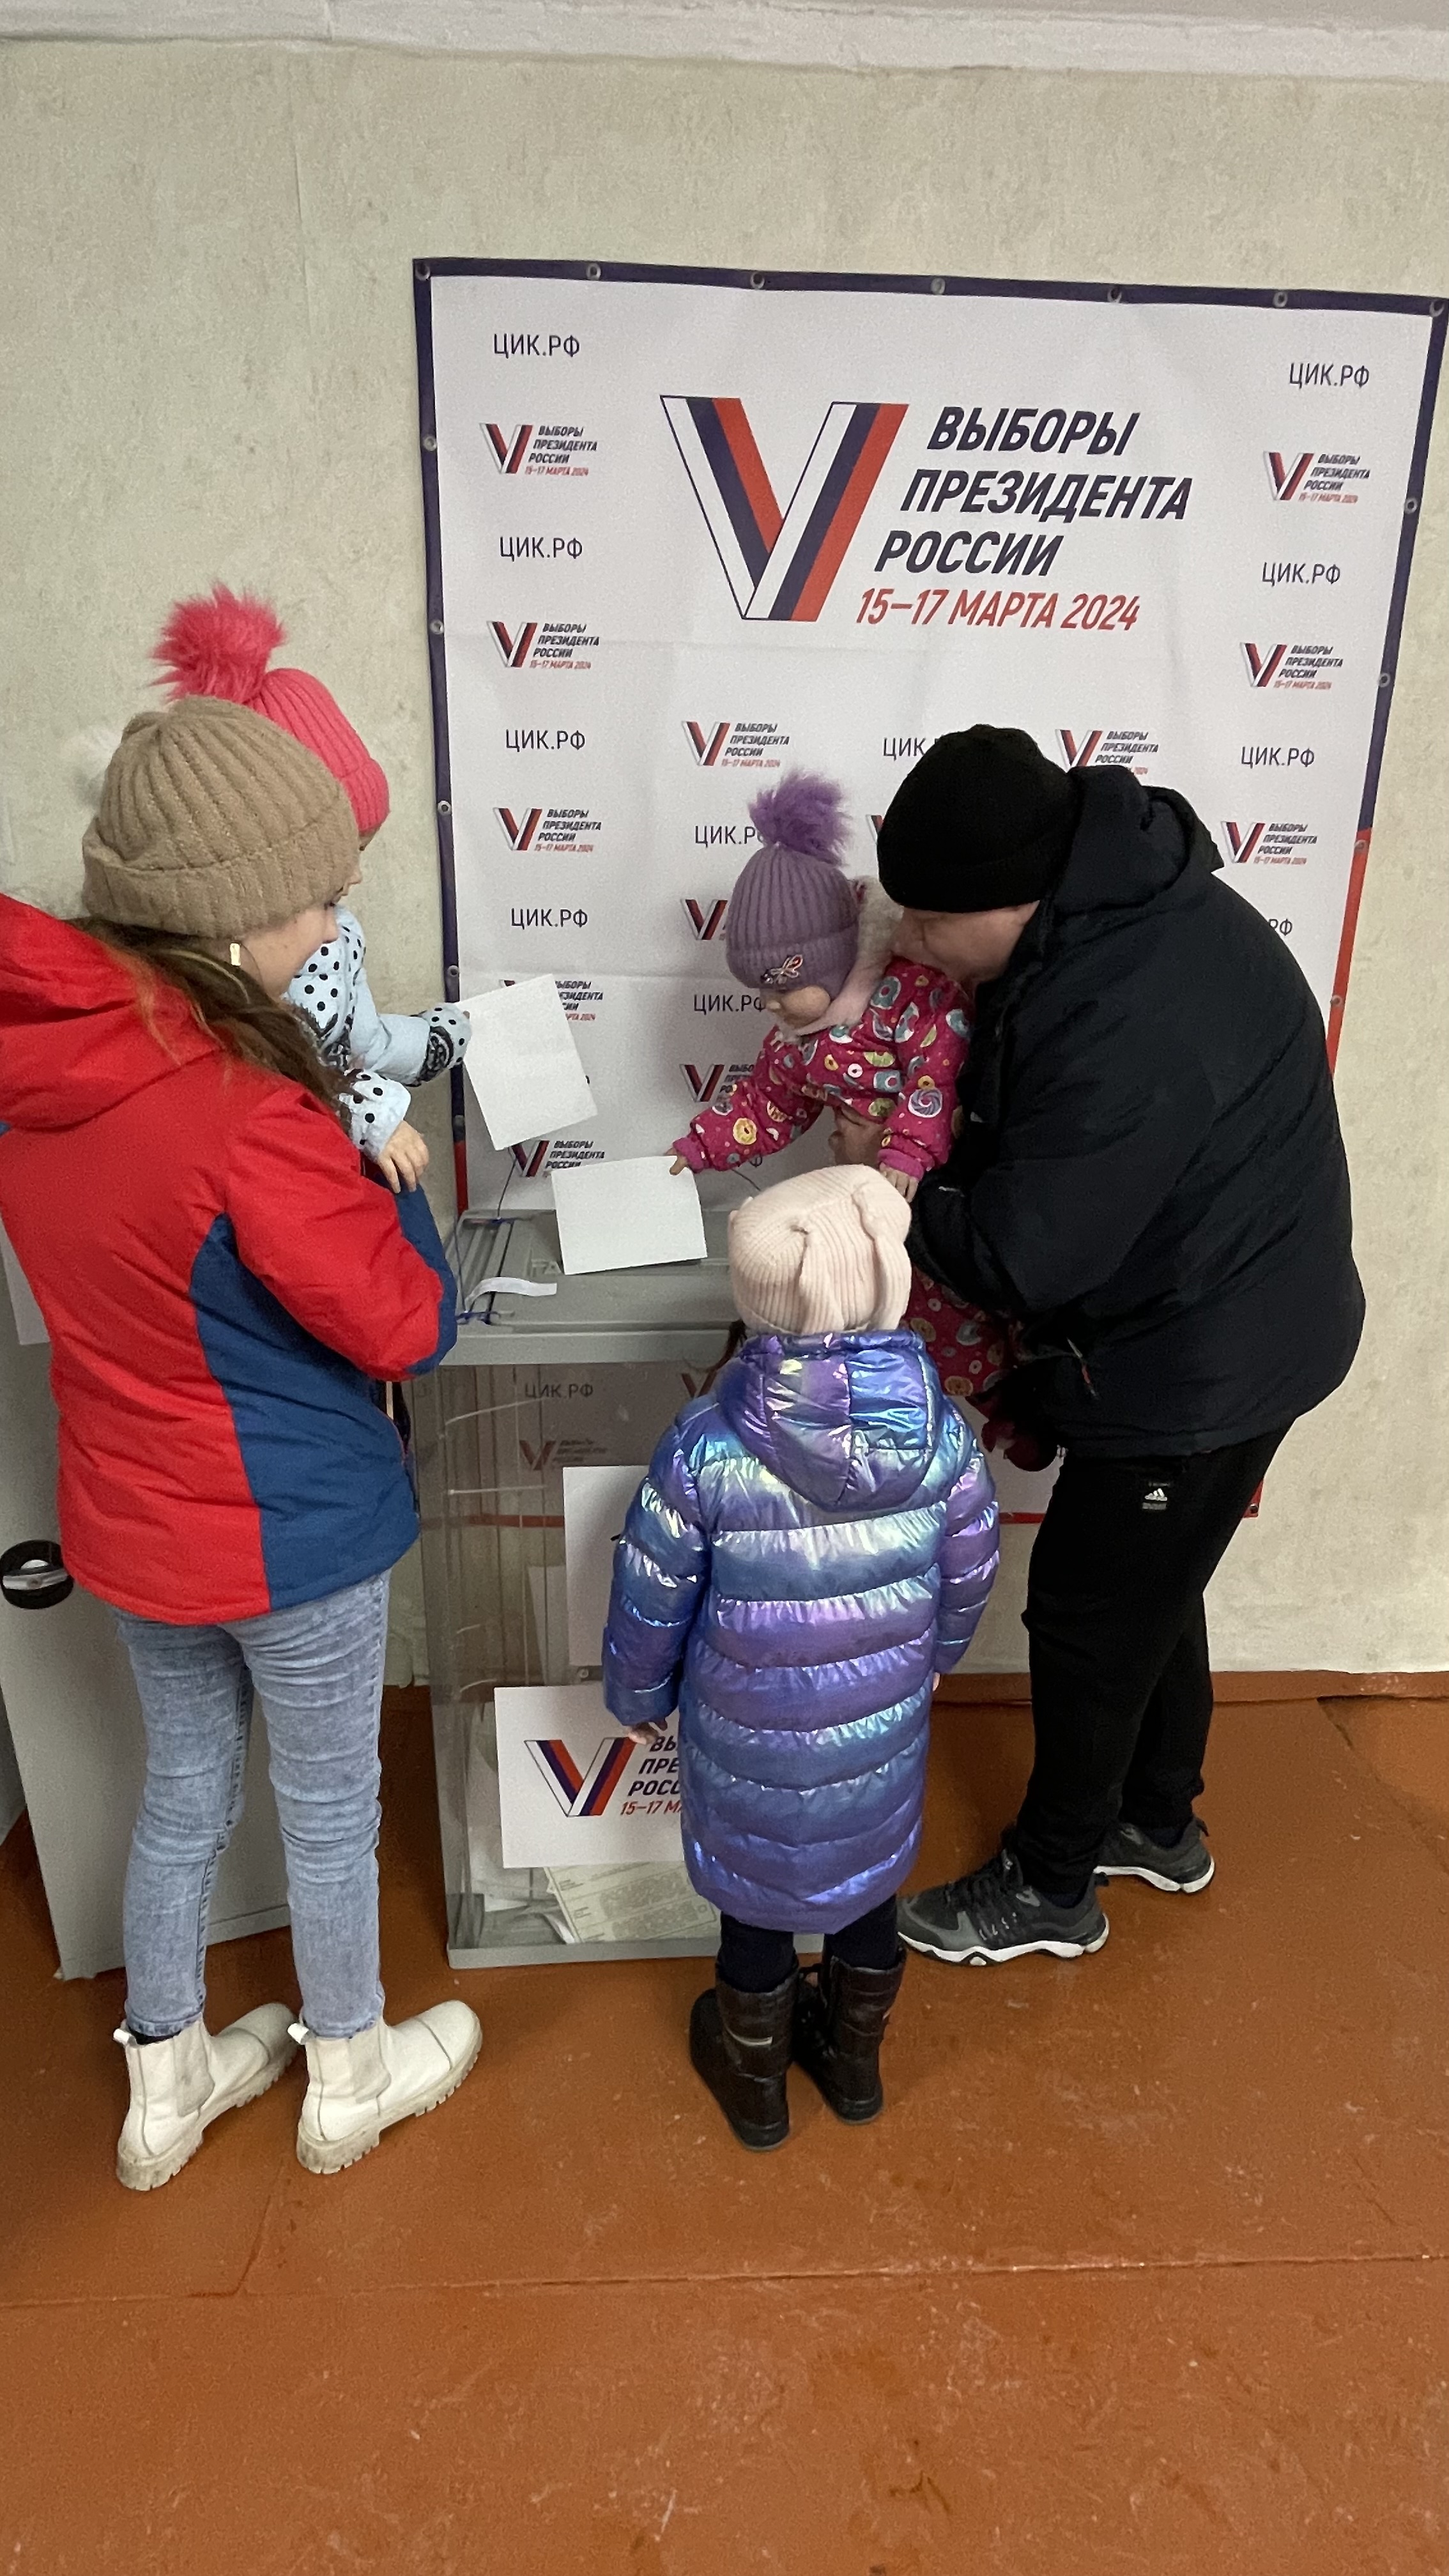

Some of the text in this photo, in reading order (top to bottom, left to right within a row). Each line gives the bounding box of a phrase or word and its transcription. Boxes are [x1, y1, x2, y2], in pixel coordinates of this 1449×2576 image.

[494, 333, 580, 358] ЦИК.РФ
[1289, 363, 1370, 389] ЦИК.РФ
[538, 425, 584, 437] ВЫБОРЫ
[927, 406, 1141, 456] ВЫБОРЫ
[533, 440, 598, 452] ПРЕЗИДЕНТА
[528, 453, 570, 464] РОССИИ
[1317, 454, 1361, 465] ВЫБОРЫ
[1310, 466, 1370, 479] ПРЕЗИДЕНТА
[1303, 480, 1344, 491] РОССИИ
[900, 468, 1193, 523] ПРЕЗИДЕНТА
[500, 536, 583, 562] ЦИК.РФ
[874, 530, 1064, 576] РОССИИ
[1262, 562, 1340, 587] ЦИК.РФ
[948, 589, 1059, 629] МАРТА
[1061, 594, 1140, 631] 2024
[542, 623, 586, 633] ВЫБОРЫ
[537, 635, 599, 647] ПРЕЗИДЕНТА
[533, 648, 573, 658] РОССИИ
[1291, 645, 1333, 655] ВЫБОРЫ
[1285, 657, 1344, 668] ПРЕЗИДЕНТА
[1278, 669, 1317, 678] РОССИИ
[735, 723, 778, 733] ВЫБОРЫ
[506, 729, 585, 752] ЦИК.РФ
[730, 735, 790, 746] ПРЕЗИДЕНТА
[1107, 731, 1149, 740] ВЫБОРЫ
[724, 747, 764, 756] РОССИИ
[1100, 742, 1159, 753] ПРЕЗИДЕНТА
[1095, 755, 1134, 763] РОССИИ
[1241, 746, 1314, 769] ЦИК.РФ
[547, 809, 589, 818] ВЫБОРЫ
[543, 820, 602, 831] ПРЕЗИДЕНТА
[1268, 823, 1308, 832] ВЫБОРЫ
[538, 832, 576, 841] РОССИИ
[1263, 834, 1318, 845] ПРЕЗИДЕНТА
[1257, 846, 1293, 854] РОССИИ
[511, 908, 588, 930] ЦИК.РФ
[628, 1780, 681, 1796] РОСС
